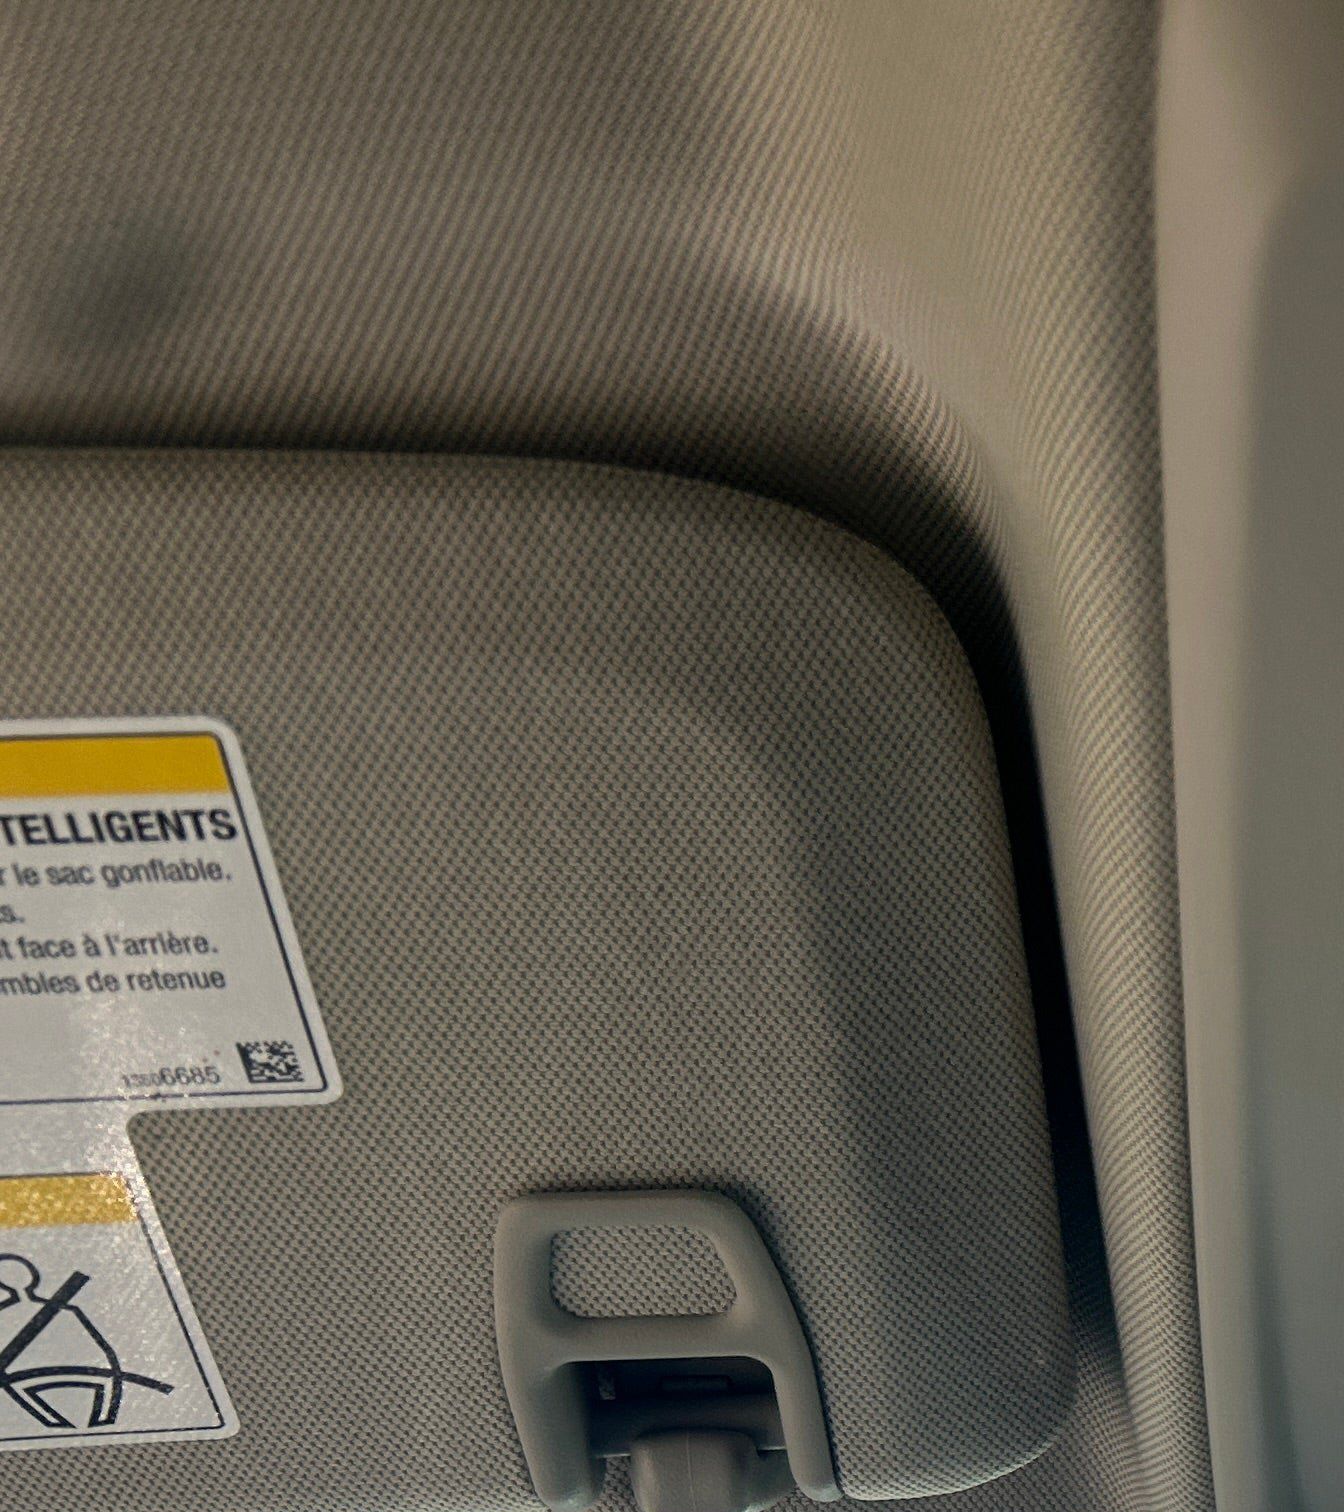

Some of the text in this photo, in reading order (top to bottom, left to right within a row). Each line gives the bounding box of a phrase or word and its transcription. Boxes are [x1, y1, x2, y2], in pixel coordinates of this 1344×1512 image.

[11, 862, 40, 886] le
[46, 864, 95, 886] sac
[101, 858, 232, 888] gonflable.
[18, 936, 77, 959] face
[82, 934, 102, 958] à
[104, 930, 218, 956] l'arrière.
[86, 971, 120, 992] de
[126, 969, 226, 991] retenue
